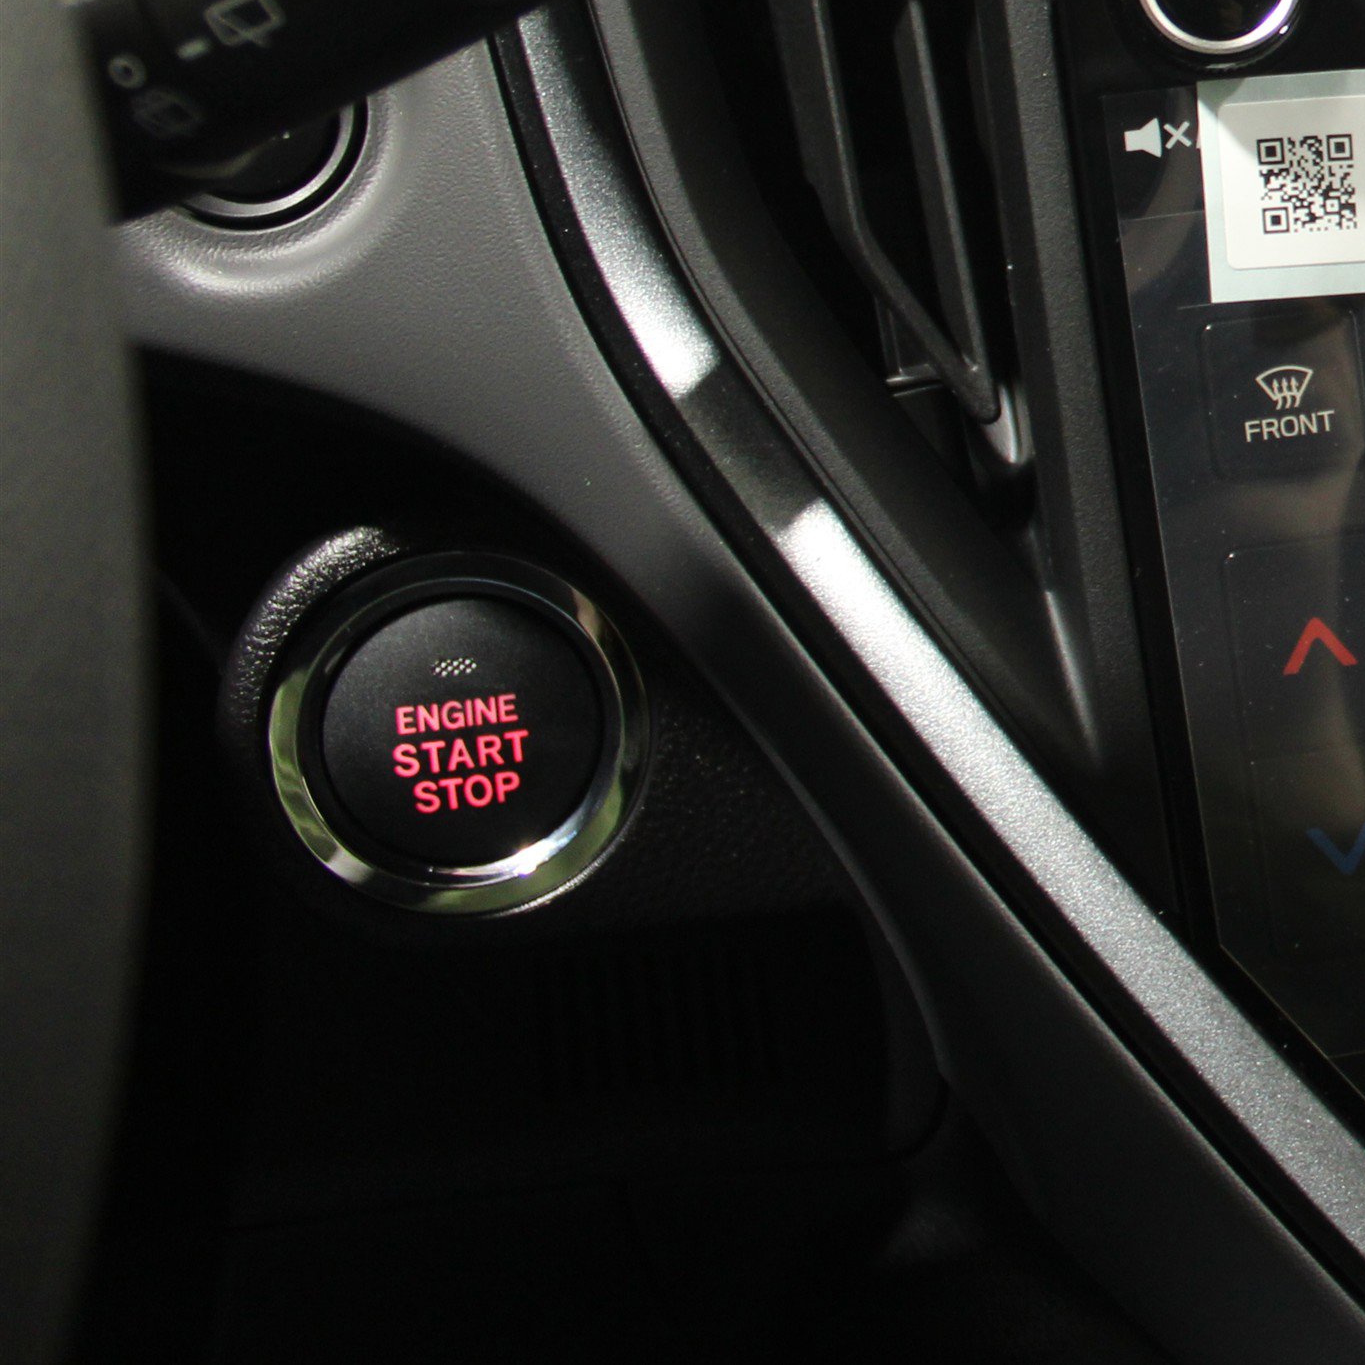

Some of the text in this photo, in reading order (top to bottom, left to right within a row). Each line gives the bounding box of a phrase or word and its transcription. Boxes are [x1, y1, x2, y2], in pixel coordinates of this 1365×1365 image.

[1244, 409, 1335, 443] FRONT
[395, 693, 519, 735] ENGINE
[392, 729, 529, 777] START
[413, 771, 520, 814] STOP
